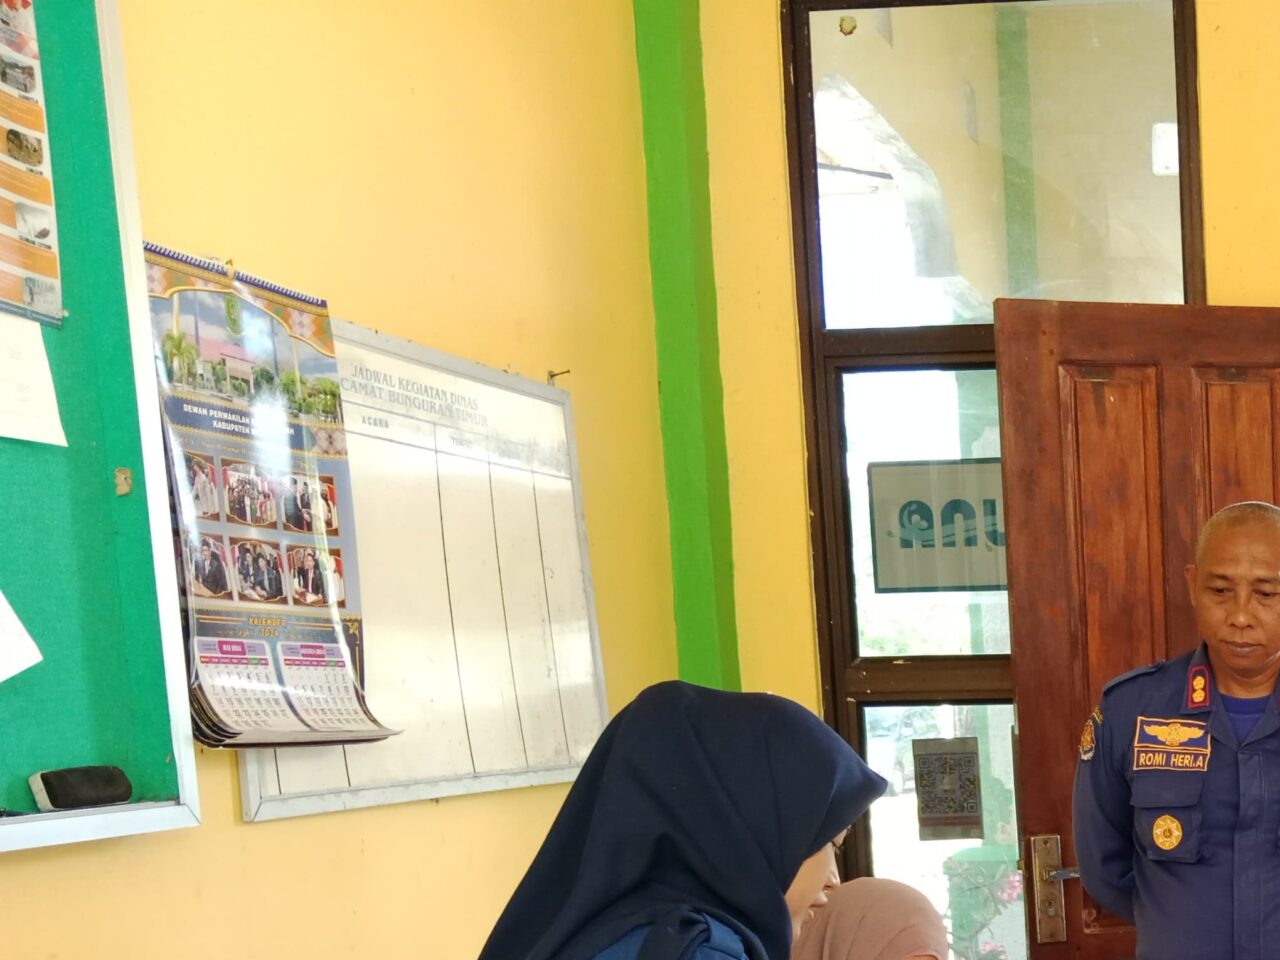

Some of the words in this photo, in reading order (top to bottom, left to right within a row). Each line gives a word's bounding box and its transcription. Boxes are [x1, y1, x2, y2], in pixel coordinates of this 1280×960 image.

[340, 377, 384, 399] CAMAT
[352, 365, 395, 388] JADWAL
[398, 376, 448, 402] KEGIATAN
[450, 391, 478, 411] DINAS
[183, 402, 208, 416] DEWAN
[1139, 752, 1165, 767] ROMI
